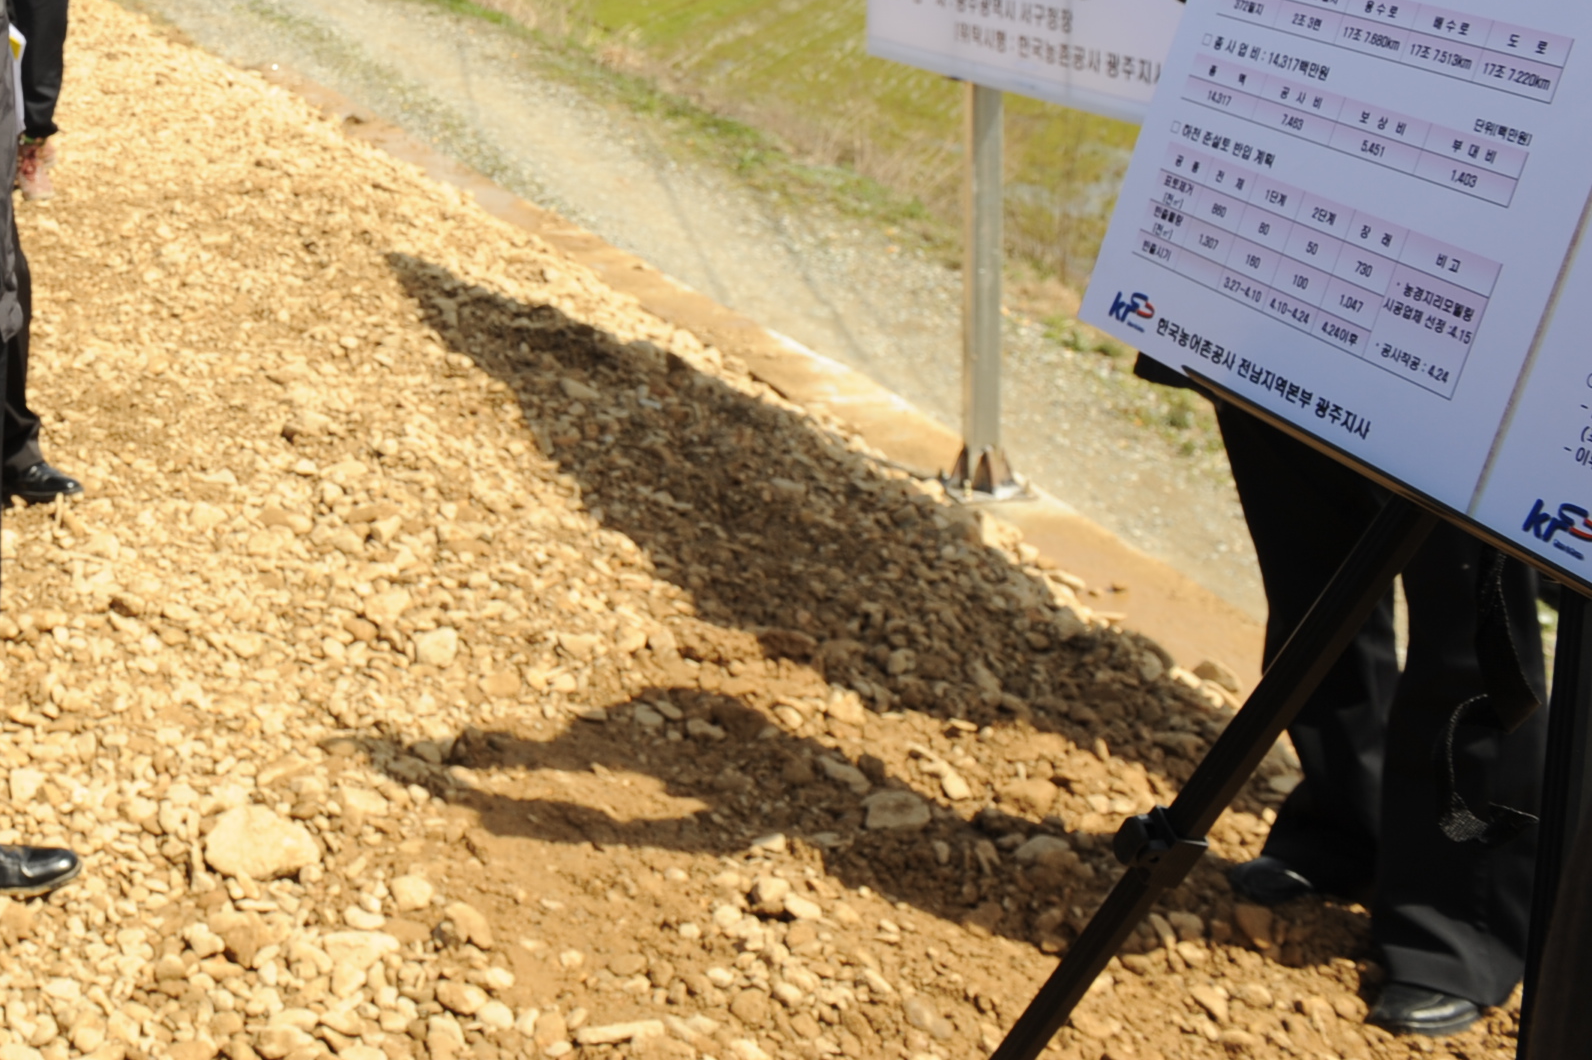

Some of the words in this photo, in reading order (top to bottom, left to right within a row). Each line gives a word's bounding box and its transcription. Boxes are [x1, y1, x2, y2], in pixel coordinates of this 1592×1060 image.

[1344, 27, 1363, 41] 17조
[1411, 44, 1431, 59] 17조
[1484, 63, 1506, 78] 17조
[1183, 124, 1201, 141] 하천
[1203, 132, 1230, 151] 준설토
[1232, 142, 1252, 160] 반입
[1254, 150, 1275, 167] 계획
[1306, 241, 1318, 255] 50
[1355, 261, 1373, 277] 730
[1293, 274, 1308, 289] 100
[1157, 318, 1236, 370] 한국농어촌공사
[1238, 358, 1313, 408] 전남지역본부
[1315, 397, 1370, 439] 광주지사
